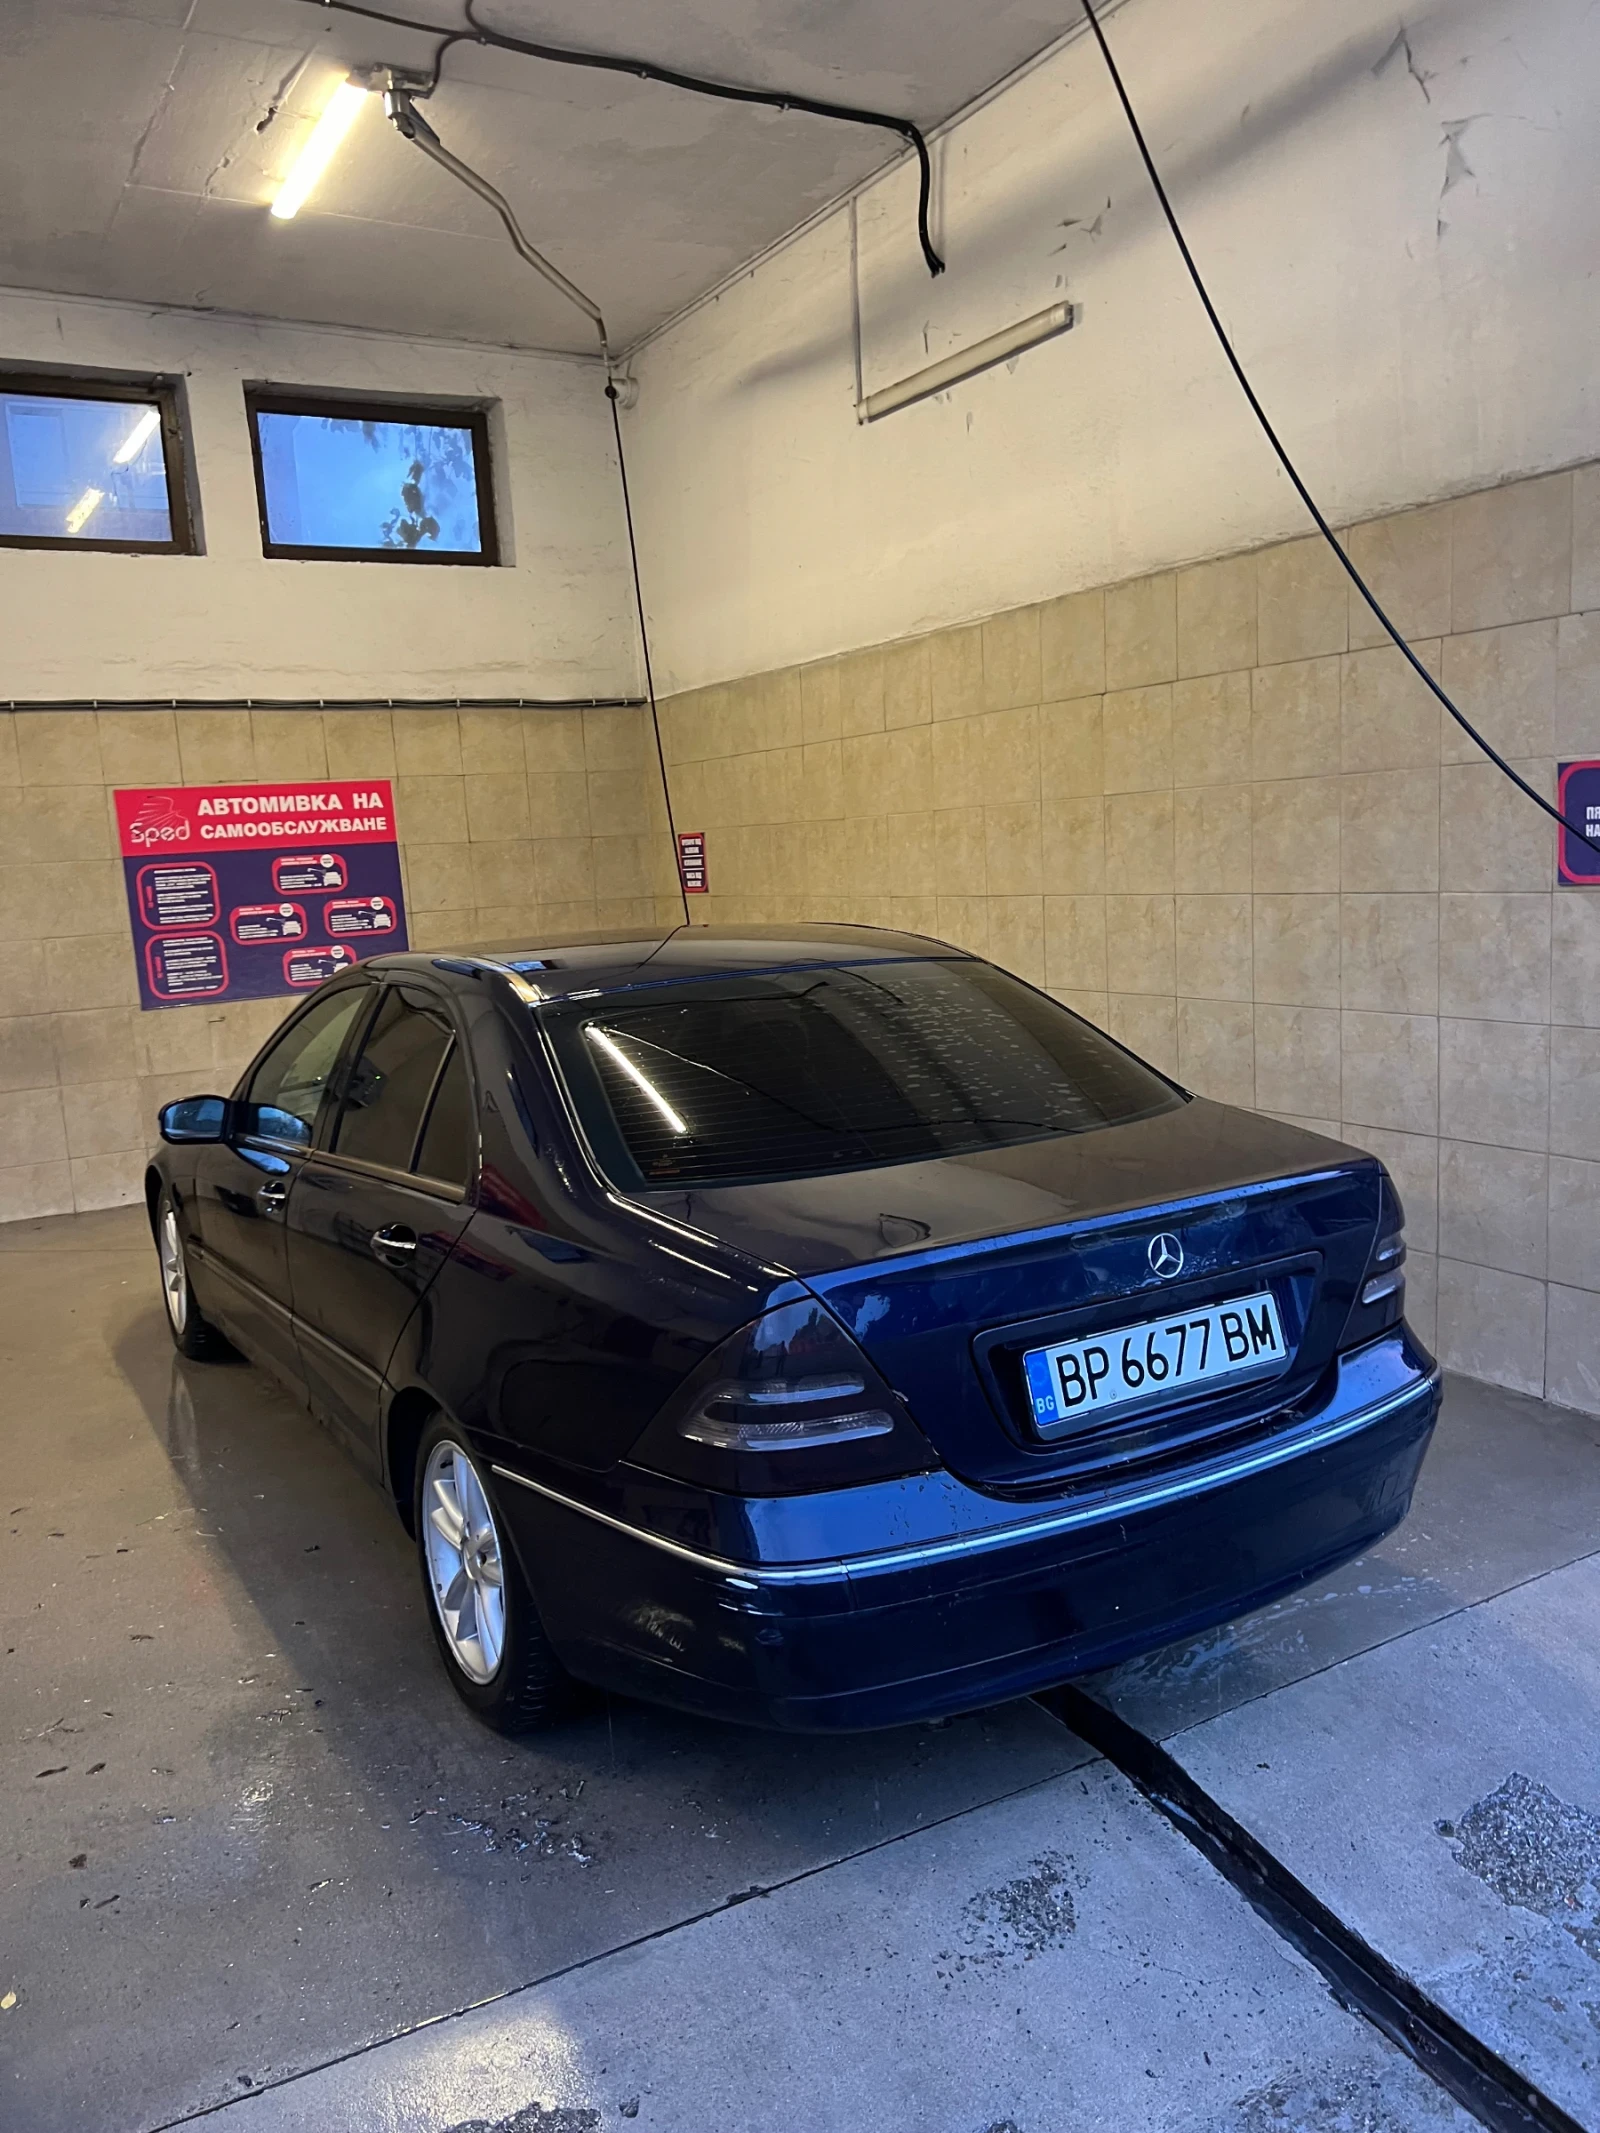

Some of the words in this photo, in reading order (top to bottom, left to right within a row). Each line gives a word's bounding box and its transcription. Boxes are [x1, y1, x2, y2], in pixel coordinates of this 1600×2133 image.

[198, 793, 343, 816] АВТОМИВКА
[353, 792, 384, 810] НА
[130, 821, 190, 848] Sped
[200, 816, 387, 840] САМООБСЛУЖВАНЕ
[1055, 1346, 1110, 1408] BP
[1121, 1318, 1210, 1388] 6677
[1219, 1303, 1277, 1362] BM
[1036, 1394, 1055, 1415] BG
